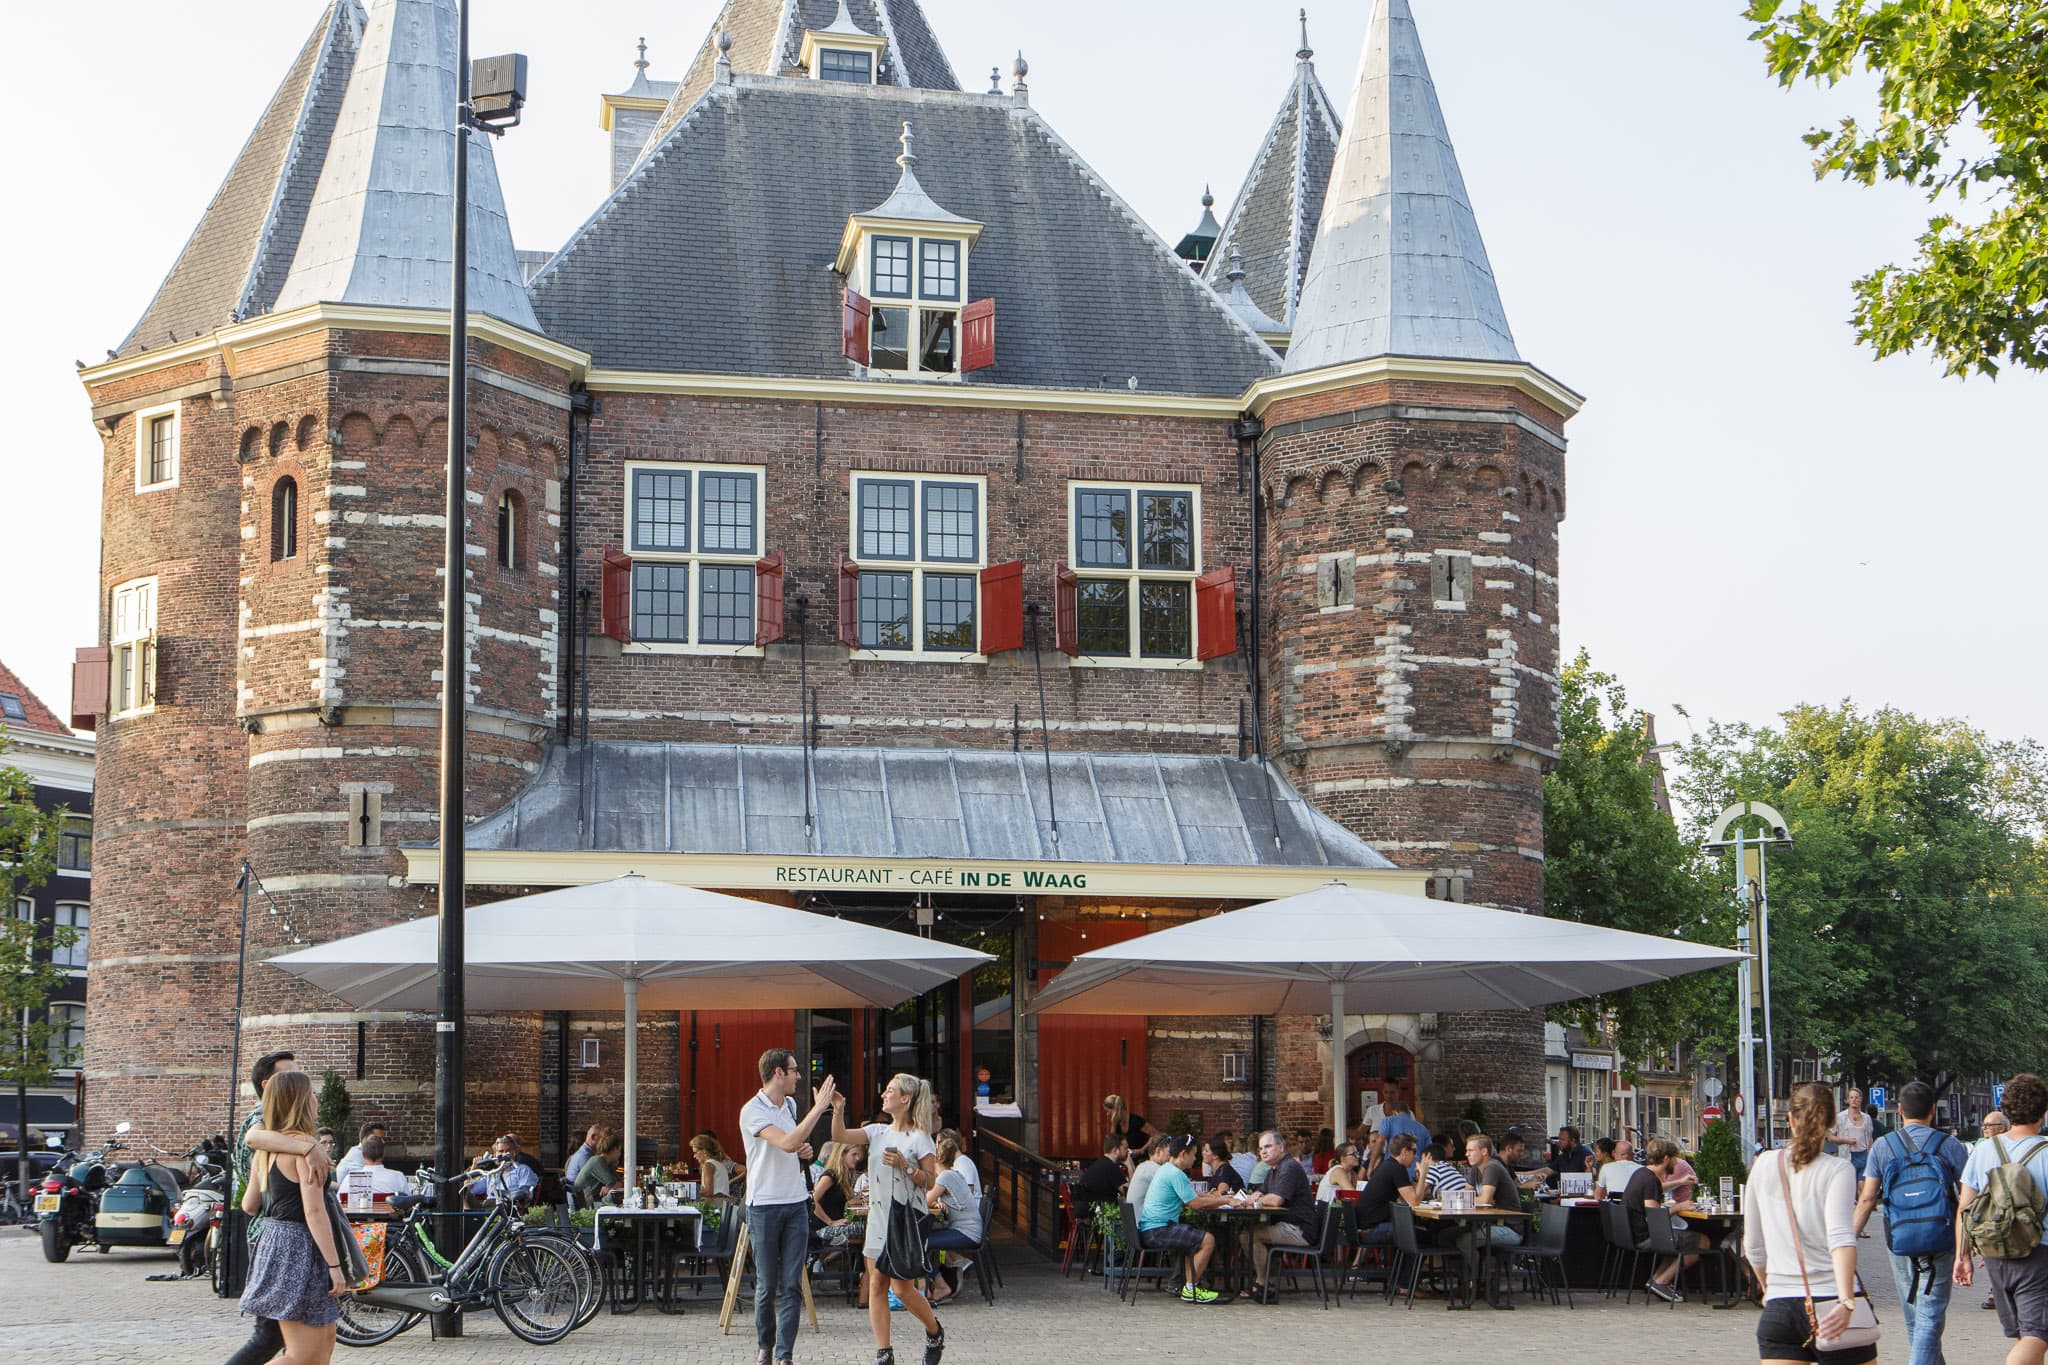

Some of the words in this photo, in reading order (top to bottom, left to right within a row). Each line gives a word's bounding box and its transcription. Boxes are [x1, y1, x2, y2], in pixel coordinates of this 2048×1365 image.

[776, 867, 894, 883] RESTAURANT
[910, 868, 953, 885] CAFÉ
[960, 872, 980, 886] IN
[986, 872, 1012, 887] DE
[1023, 871, 1087, 888] WAAG
[1872, 1089, 1881, 1100] P
[1996, 1086, 2005, 1099] P
